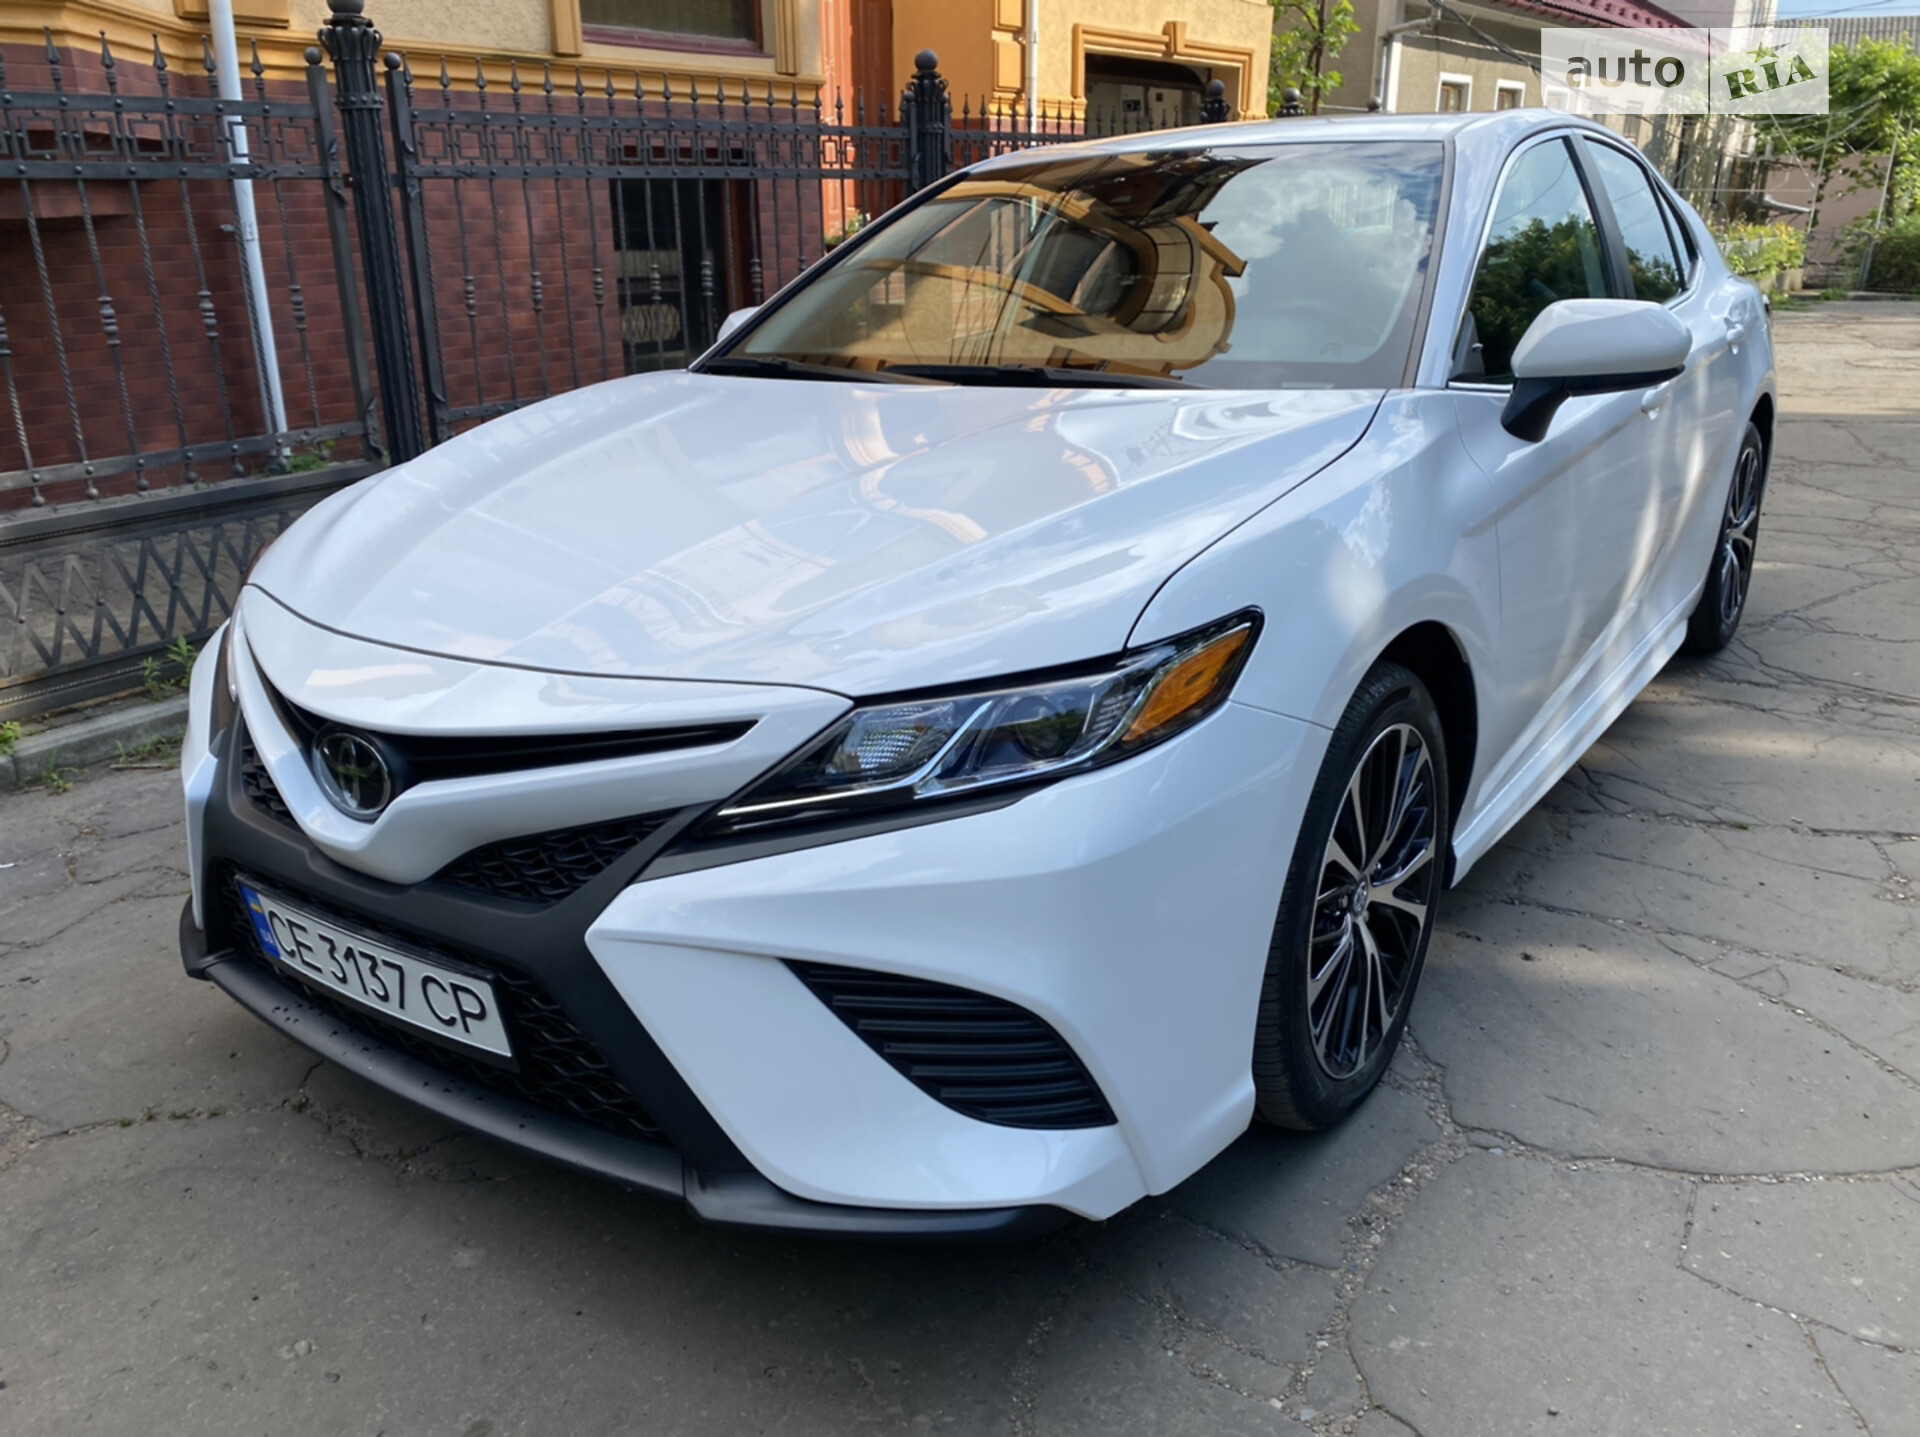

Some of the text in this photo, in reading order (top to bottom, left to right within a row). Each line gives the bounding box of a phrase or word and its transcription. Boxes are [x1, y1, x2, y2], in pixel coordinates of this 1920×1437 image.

[268, 910, 487, 1034] CE 3137 CP
